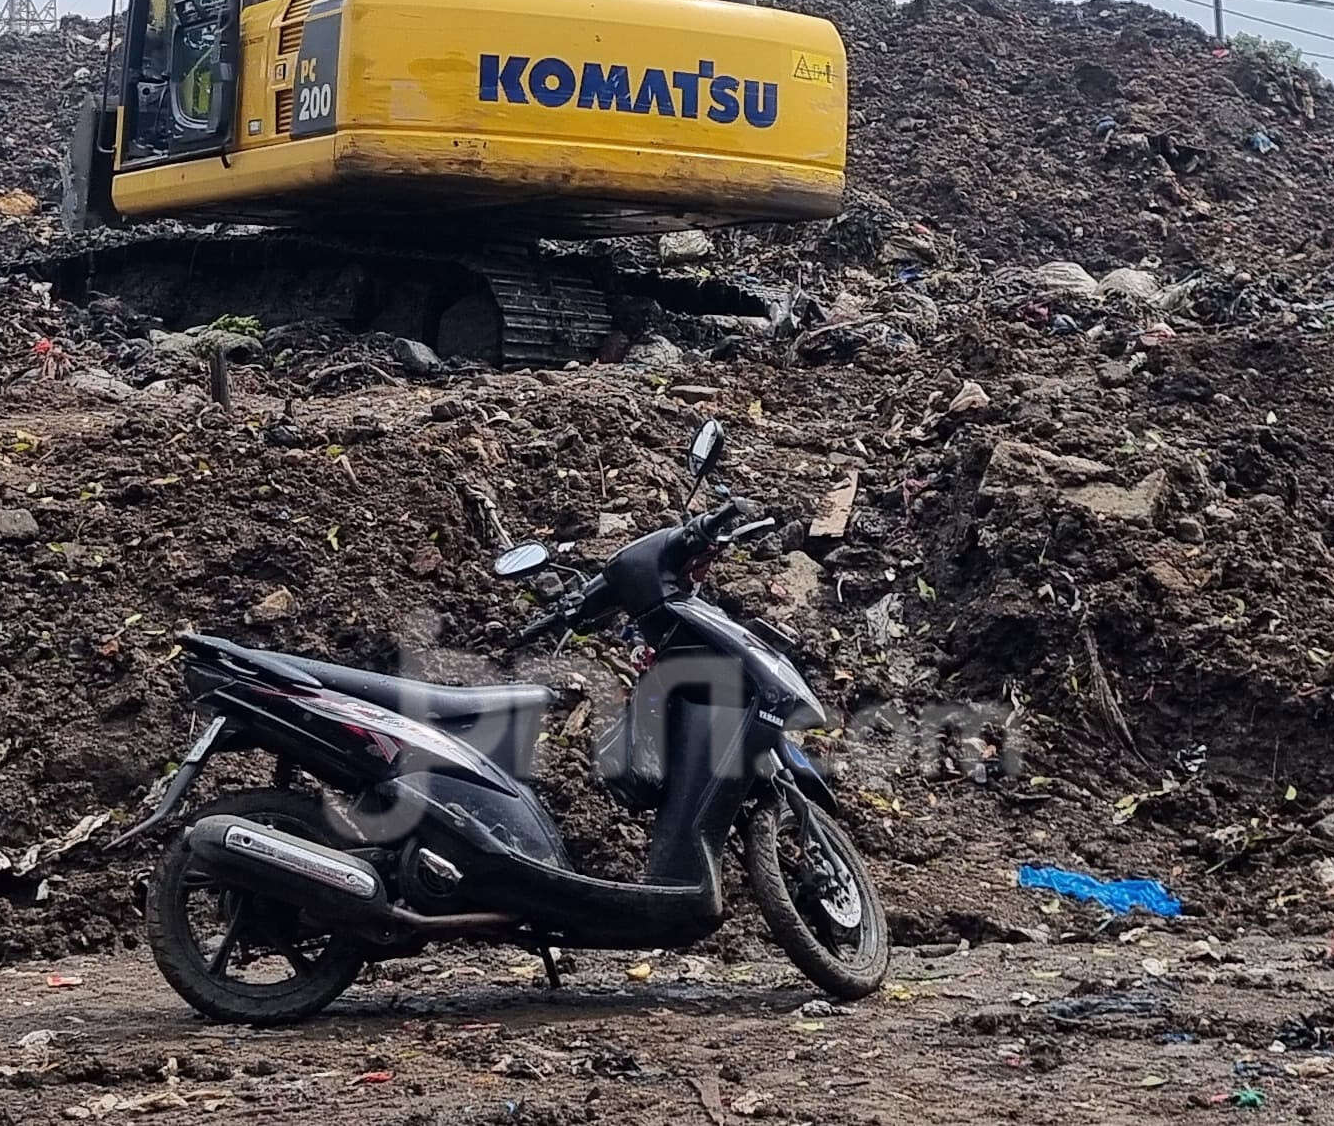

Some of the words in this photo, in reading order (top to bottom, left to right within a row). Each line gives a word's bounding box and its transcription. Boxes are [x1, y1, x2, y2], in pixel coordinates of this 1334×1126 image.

[300, 57, 317, 84] PC
[298, 83, 331, 121] 200
[479, 54, 778, 128] KOMATSU
[758, 709, 784, 727] YAMAHA
